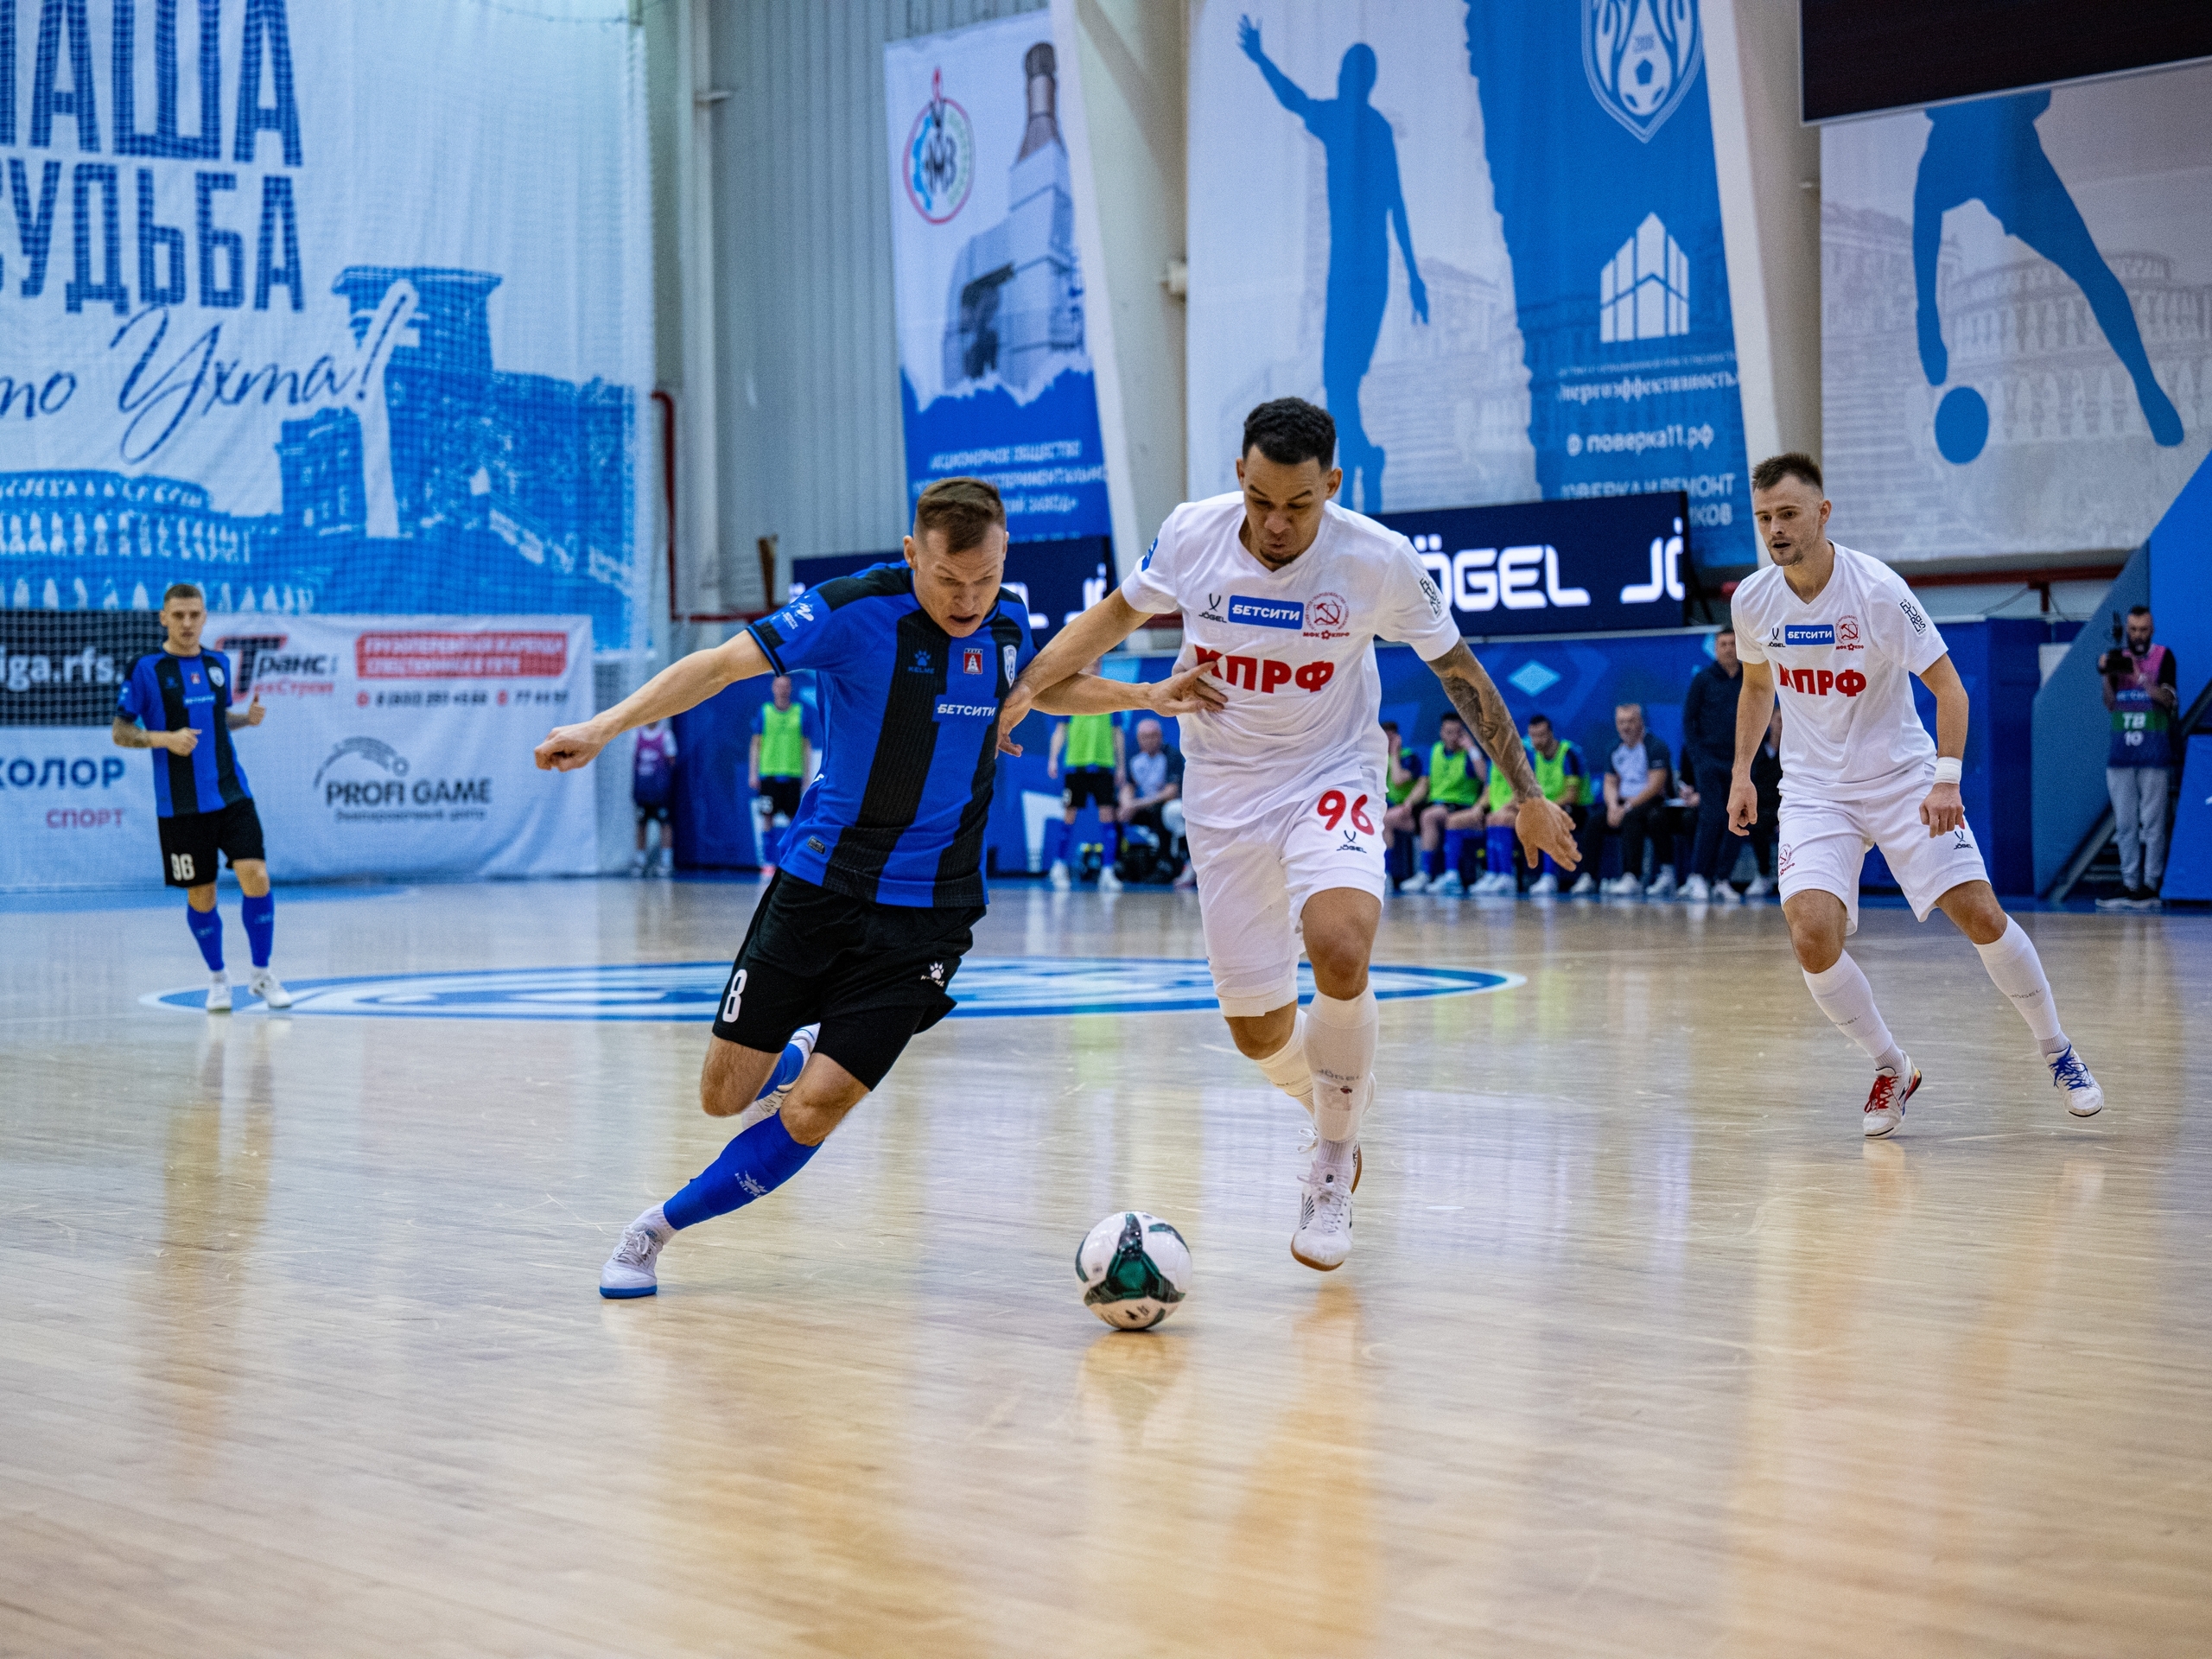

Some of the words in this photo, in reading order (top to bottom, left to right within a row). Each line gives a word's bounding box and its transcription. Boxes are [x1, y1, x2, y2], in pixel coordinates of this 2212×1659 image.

[0, 0, 302, 168] АША
[0, 156, 306, 316] УДЬБА
[110, 293, 409, 466] Ухта!
[1586, 423, 1714, 455] поверка11.рф
[1198, 610, 1228, 624] JÖGEL
[1232, 604, 1300, 621] БЕТСИТИ
[1787, 630, 1833, 639] БЕТСИТИ
[907, 666, 935, 675] KELME
[1194, 645, 1335, 694] КПРФ
[1777, 663, 1867, 698] КПРФ
[938, 703, 996, 717] БЕТСИТИ
[2122, 712, 2146, 729] ТВ
[2124, 730, 2144, 746] 10
[0, 758, 125, 789] ОЛОР
[326, 779, 405, 807] PROFI
[411, 778, 493, 804] GAME
[47, 808, 124, 829] СПОРТ
[1317, 790, 1375, 836] 96
[1336, 844, 1367, 854] JÖGEL
[722, 969, 748, 1023] 8
